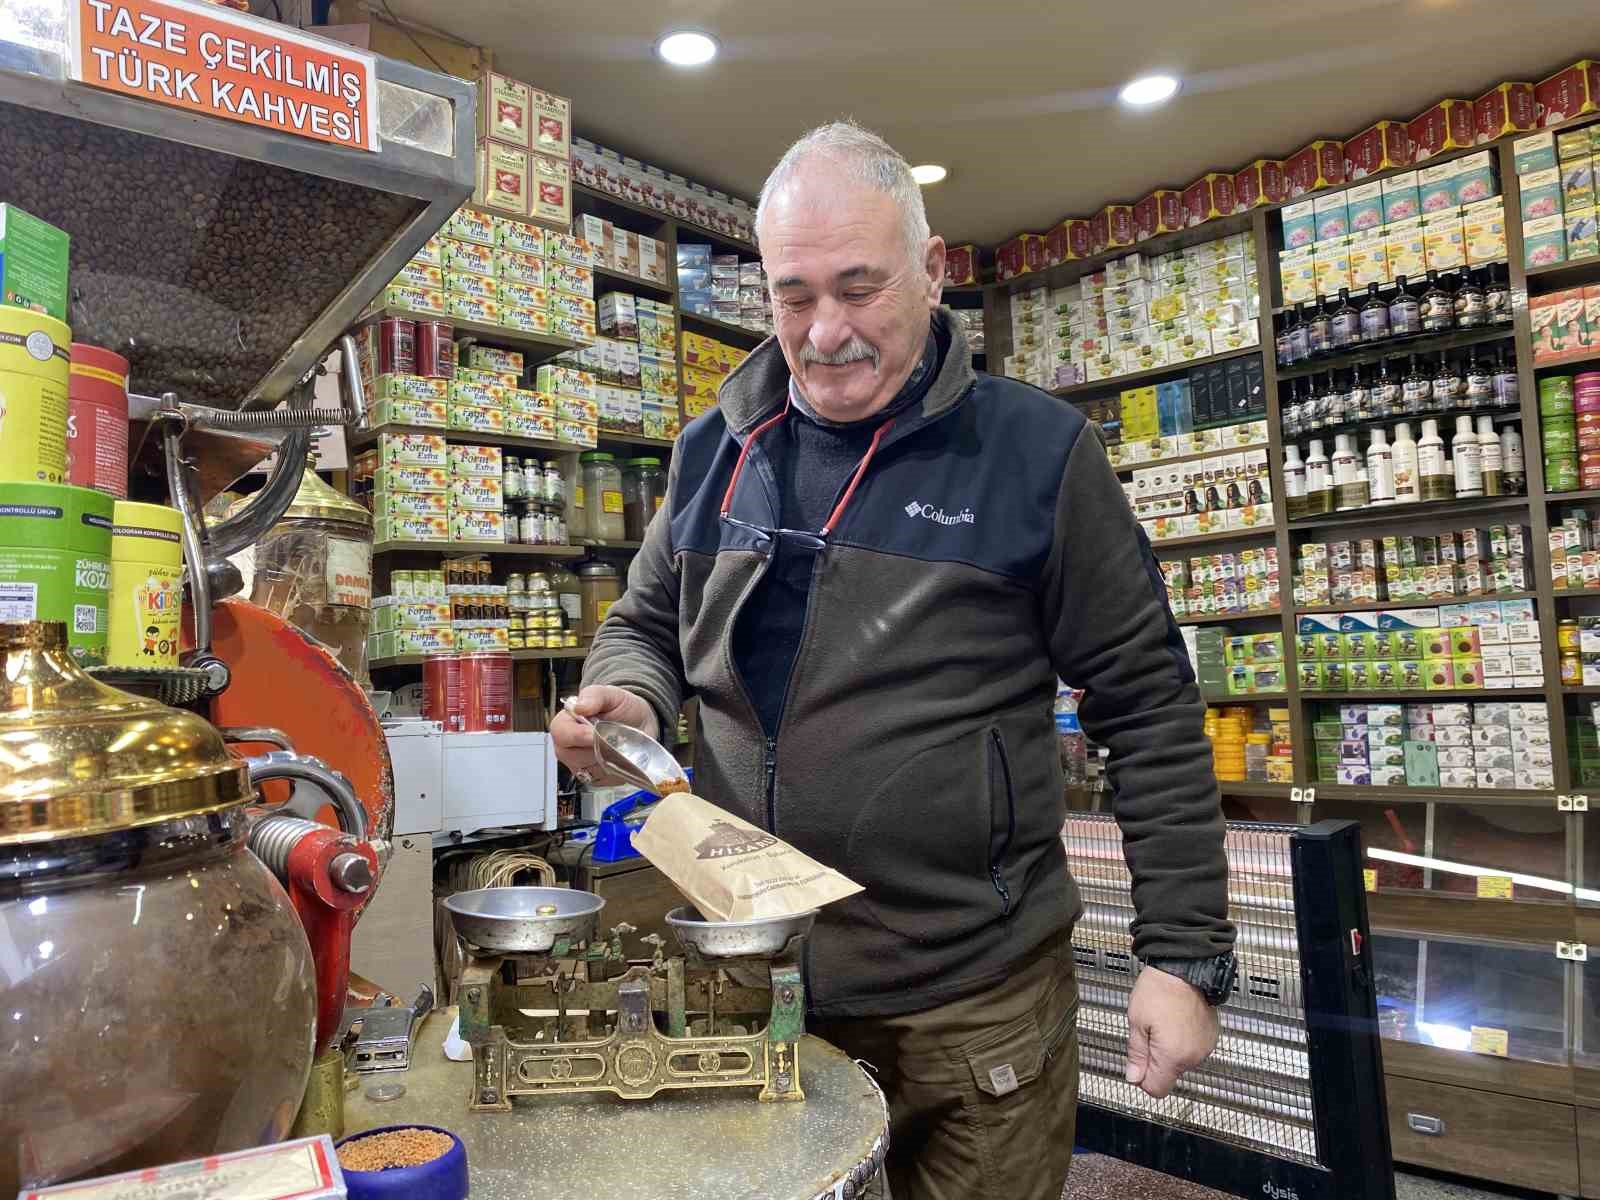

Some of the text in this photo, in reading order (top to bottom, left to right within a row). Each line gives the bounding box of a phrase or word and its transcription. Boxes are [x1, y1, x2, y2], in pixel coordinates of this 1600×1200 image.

[88, 0, 362, 108] TAZE ÇEKİLMİŞ
[91, 46, 361, 144] TÜRK KAHVESİ
[402, 442, 432, 454] Form
[461, 452, 489, 464] Form
[462, 486, 490, 498] Form
[921, 504, 975, 525] Columbia
[464, 516, 492, 528] Form
